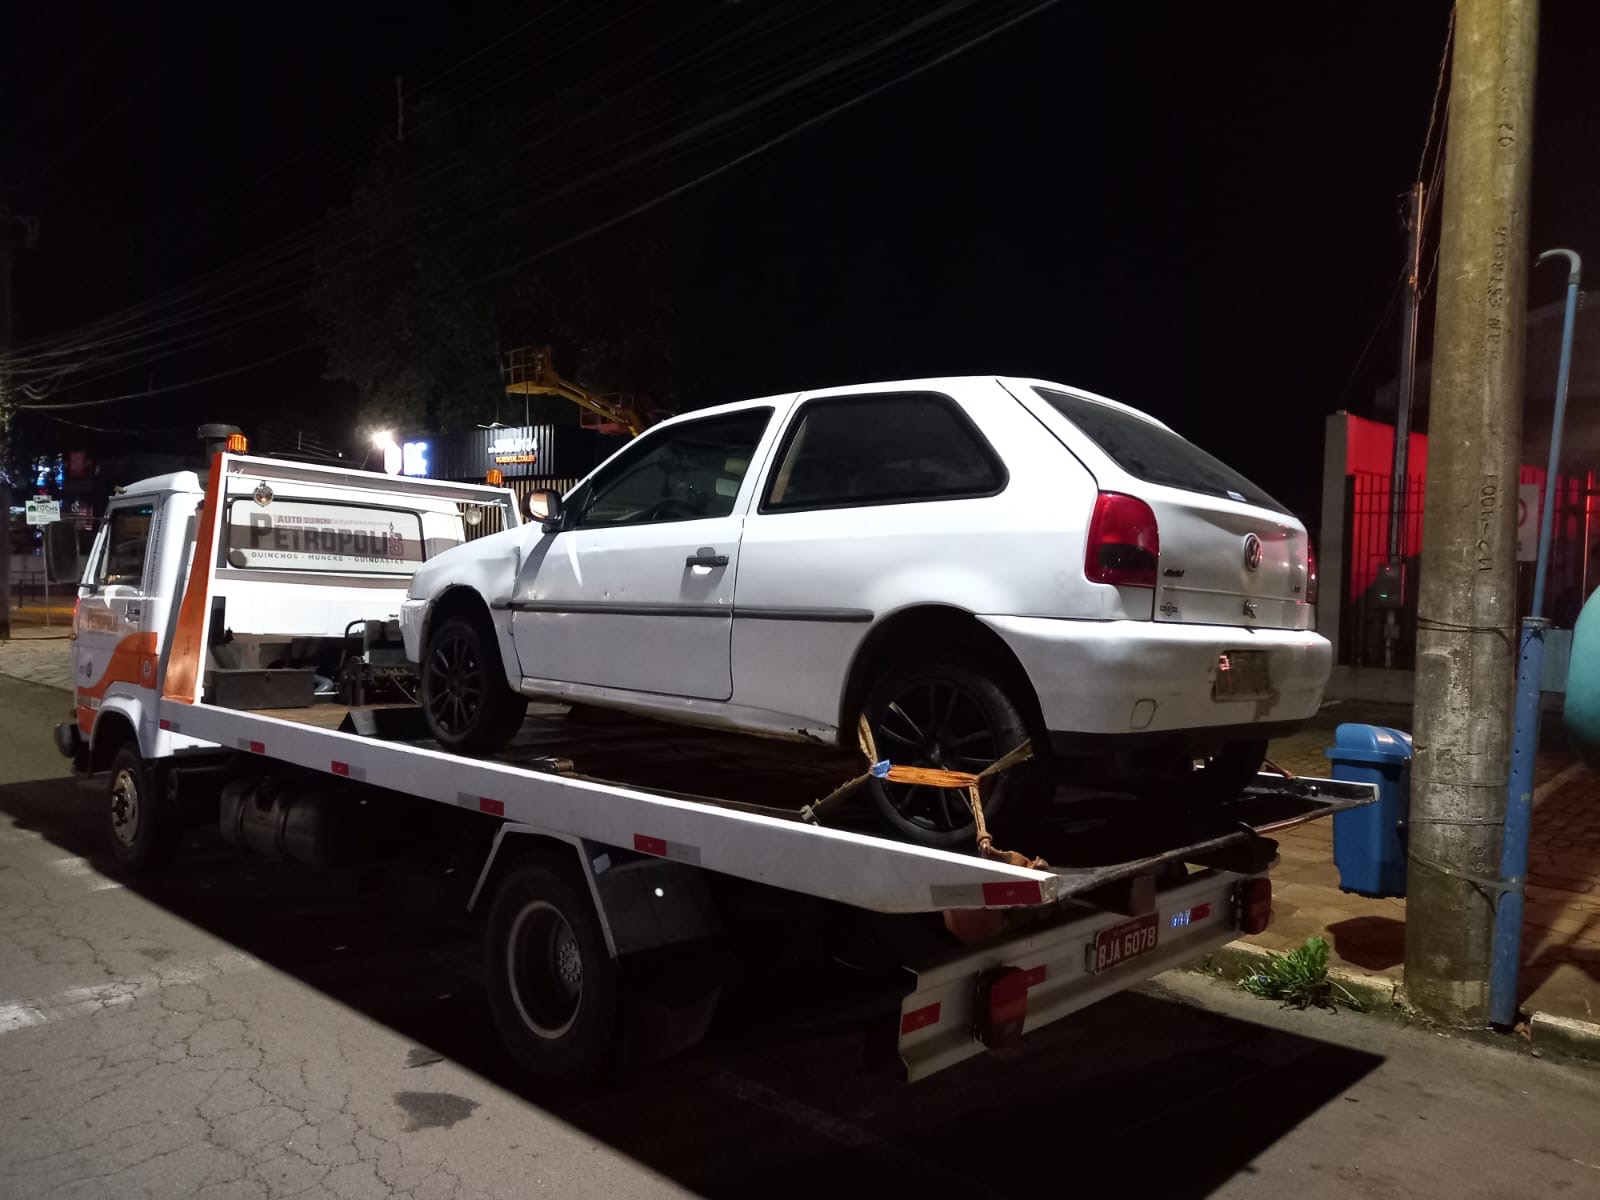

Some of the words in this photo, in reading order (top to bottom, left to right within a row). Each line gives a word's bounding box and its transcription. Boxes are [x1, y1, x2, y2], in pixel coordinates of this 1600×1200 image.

[277, 515, 302, 524] AUTO
[251, 551, 299, 560] GUINCHOS
[1098, 938, 1120, 968] BJA
[1124, 926, 1156, 956] 6078
